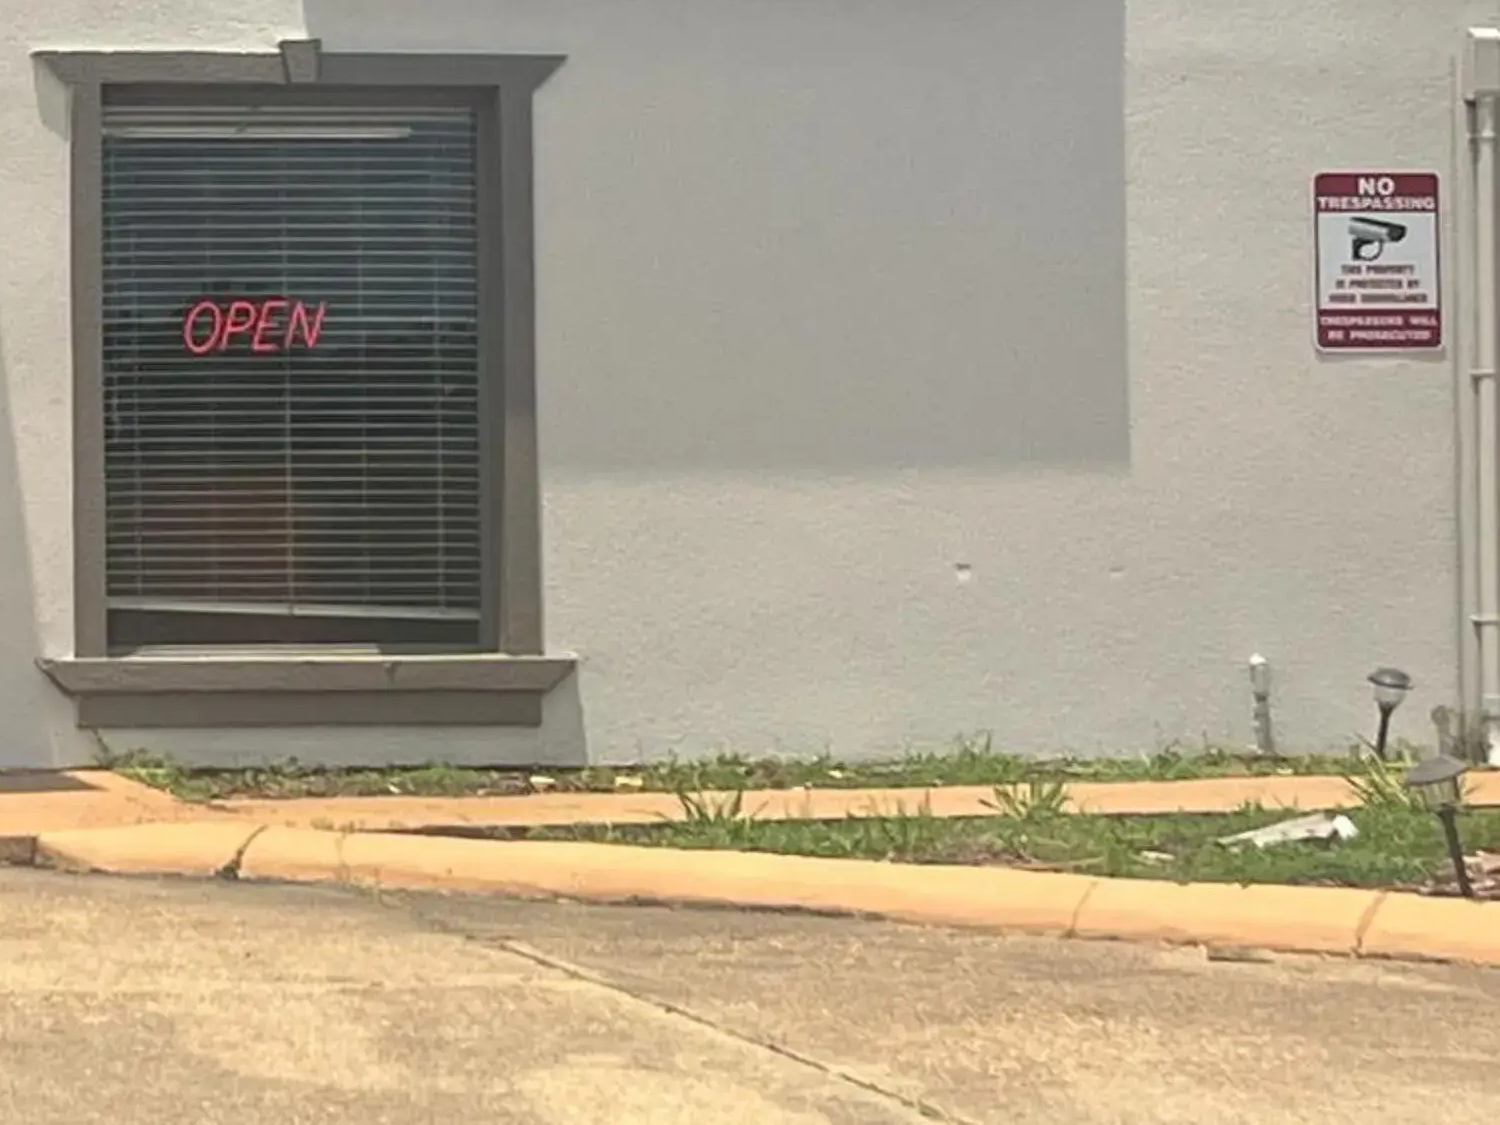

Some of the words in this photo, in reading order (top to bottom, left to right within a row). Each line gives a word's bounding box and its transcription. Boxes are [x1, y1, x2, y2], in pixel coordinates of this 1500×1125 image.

[1358, 177, 1396, 196] NO
[1318, 197, 1436, 210] TRESPASSING
[184, 301, 326, 353] OPEN
